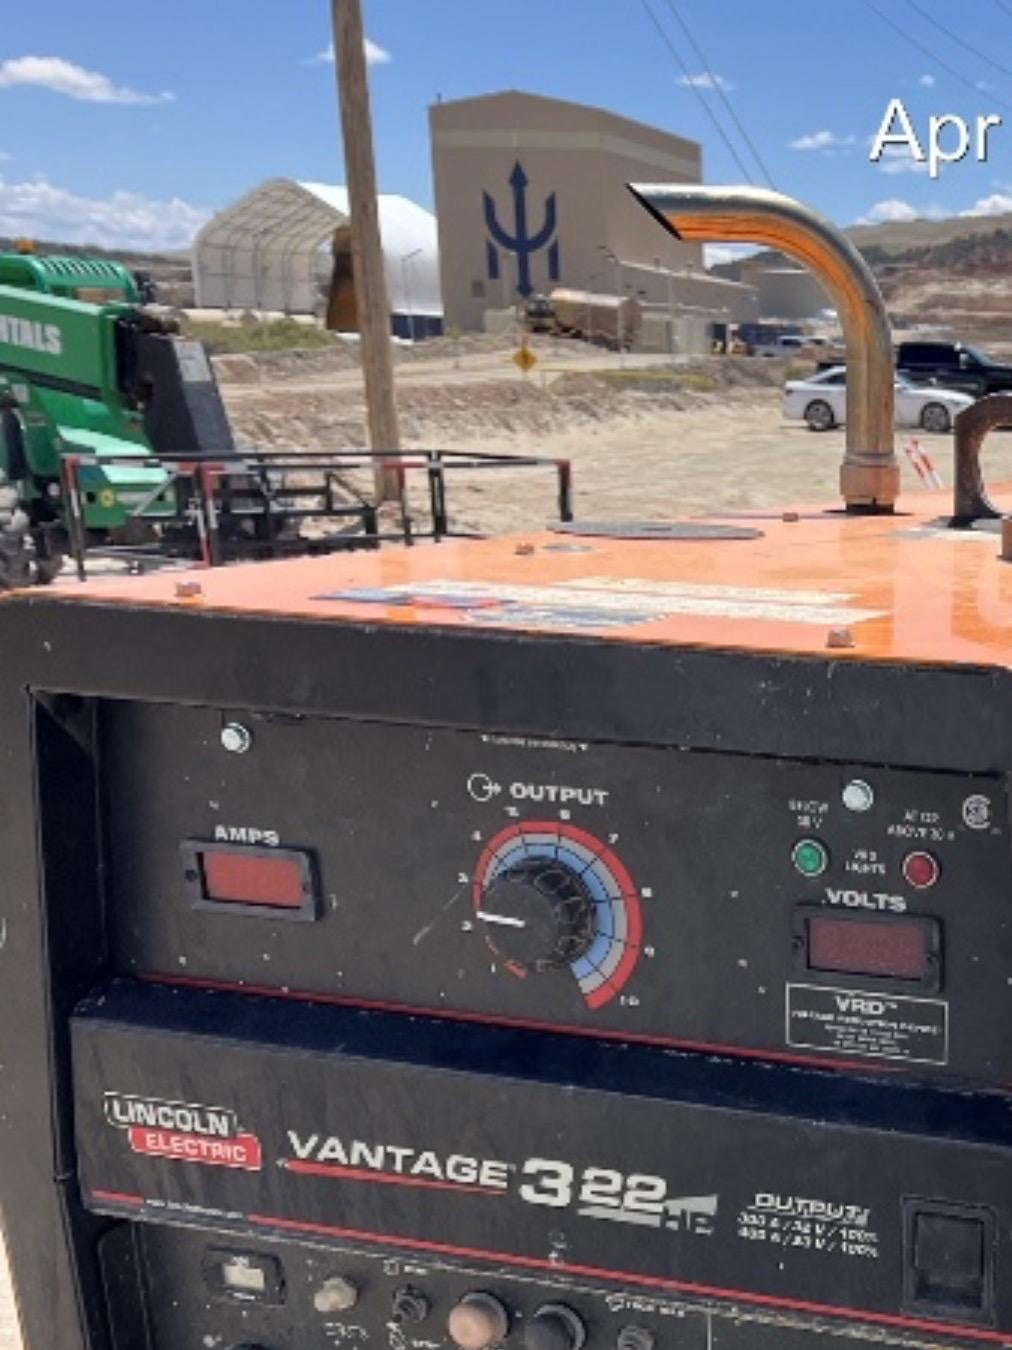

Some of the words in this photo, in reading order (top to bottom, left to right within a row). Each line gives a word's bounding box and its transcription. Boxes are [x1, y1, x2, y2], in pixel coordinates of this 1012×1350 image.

[509, 782, 610, 807] OUTPUT
[213, 824, 280, 848] AMPS
[826, 887, 907, 912] VOLTS
[112, 1098, 229, 1138] LINCOLN
[144, 1133, 247, 1162] ELECTRIC
[287, 1129, 509, 1189] VANTAGE
[519, 1156, 668, 1215] 322
